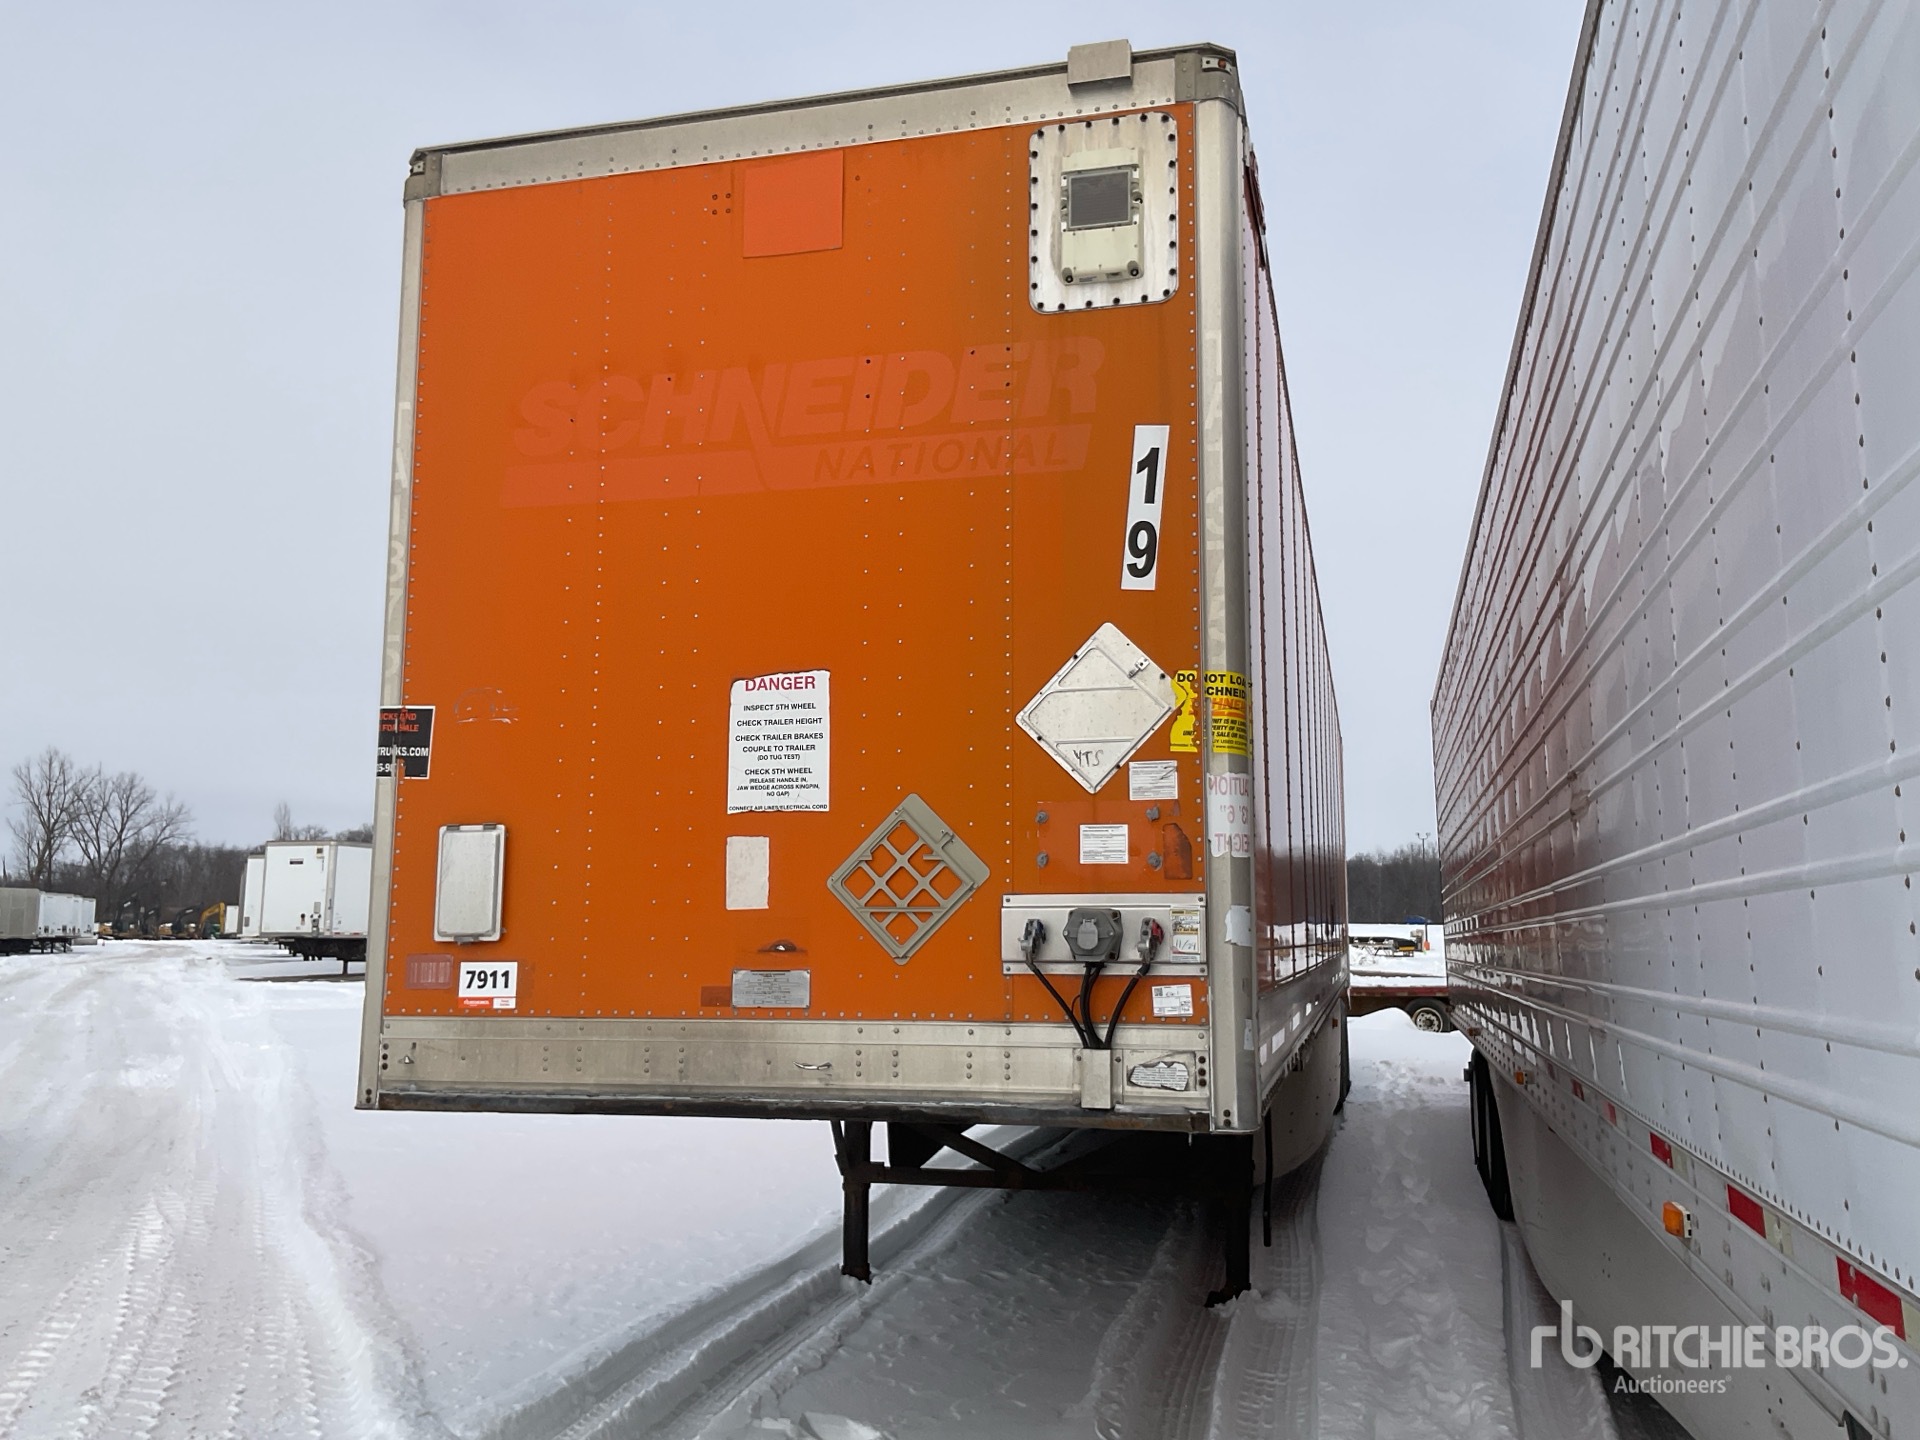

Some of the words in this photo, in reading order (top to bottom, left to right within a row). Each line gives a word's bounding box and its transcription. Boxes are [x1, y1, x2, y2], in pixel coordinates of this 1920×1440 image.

[514, 336, 1105, 456] SCHNEIDER
[814, 434, 1066, 482] NATIONAL
[1177, 673, 1195, 682] DO
[745, 676, 816, 692] DANGER
[791, 702, 816, 710] WHEEL
[736, 719, 762, 727] CHECK
[764, 718, 794, 726] TRAILER
[795, 717, 822, 725] HEIGHT
[735, 734, 761, 742] CHECK
[762, 733, 793, 741] TRAILER
[794, 732, 824, 740] BRAKES
[742, 745, 772, 753] COUPLE
[771, 767, 786, 775] 5TH
[466, 970, 510, 989] 7911
